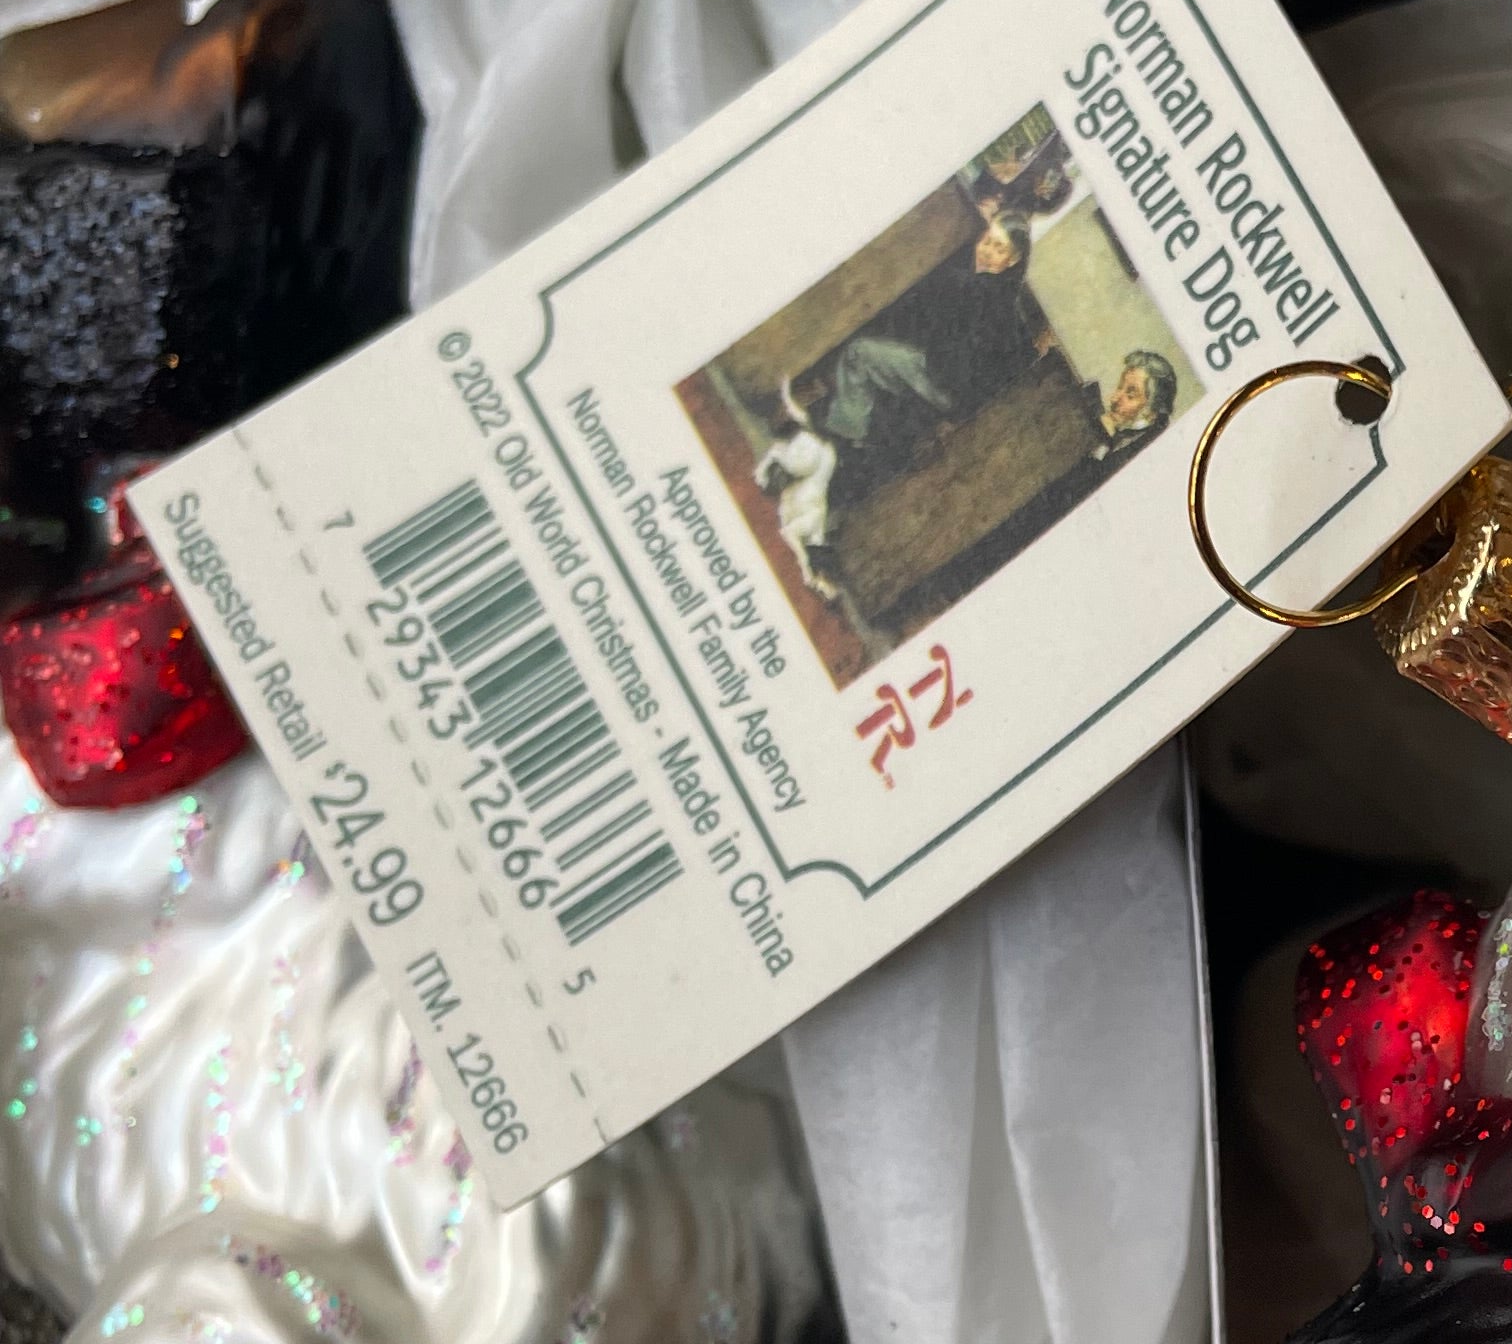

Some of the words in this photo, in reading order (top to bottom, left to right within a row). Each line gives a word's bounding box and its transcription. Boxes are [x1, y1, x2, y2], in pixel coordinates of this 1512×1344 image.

[1063, 42, 1202, 263] Signature
[1181, 244, 1262, 373] Dog
[1194, 130, 1342, 349] Rockwell
[322, 509, 357, 533] 7
[363, 584, 474, 741] 29343
[459, 757, 560, 911] 12666
[561, 966, 597, 997] 5
[449, 359, 513, 439] 2022
[492, 431, 544, 493] Old
[522, 483, 591, 580] World
[568, 572, 661, 724] Christmas
[657, 735, 722, 837] Made
[706, 829, 742, 876] in
[728, 871, 795, 979] China
[565, 386, 637, 499] Norman
[622, 491, 708, 618] Rockwell
[688, 610, 752, 710] Family
[735, 707, 808, 814] Agency
[658, 464, 748, 595] Approved
[727, 587, 763, 632] by
[749, 627, 788, 679] the
[162, 490, 277, 665] Suggested
[253, 658, 328, 763] Retail
[308, 760, 426, 928] $24.99
[404, 950, 463, 1033] ITM.
[445, 1032, 530, 1155] 12666
